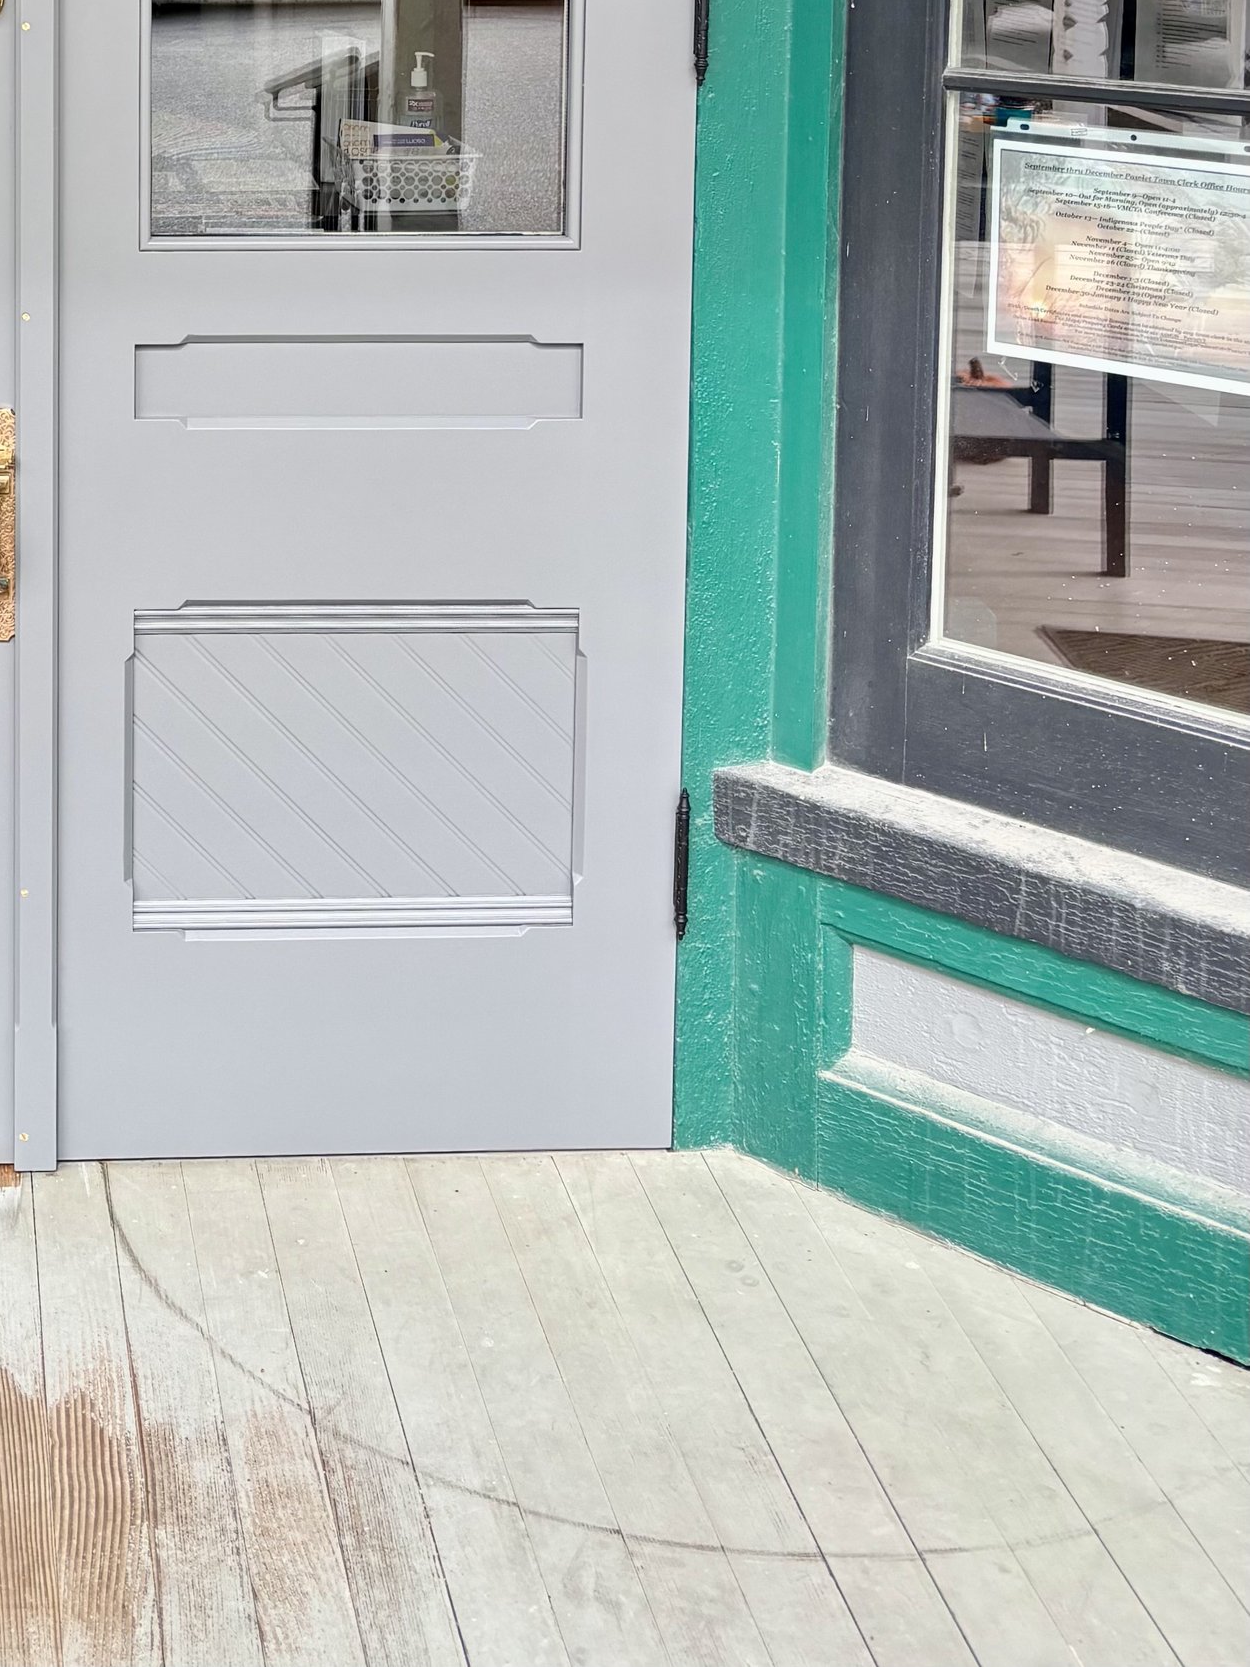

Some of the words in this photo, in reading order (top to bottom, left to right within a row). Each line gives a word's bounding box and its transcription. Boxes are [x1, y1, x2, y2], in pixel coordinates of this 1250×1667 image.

[1024, 161, 1065, 174] September
[1066, 166, 1083, 176] thru
[1085, 169, 1124, 180] December
[1177, 178, 1200, 189] Clerk
[1200, 181, 1224, 191] Office
[1093, 187, 1131, 198] September
[1091, 194, 1103, 202] for
[1138, 200, 1158, 209] Open
[1054, 197, 1093, 208] September
[1184, 212, 1216, 223] (Closed)
[1055, 211, 1083, 221] October
[1183, 225, 1215, 237] (Closed)
[1097, 222, 1125, 232] October
[1070, 240, 1107, 250] November
[1085, 235, 1123, 245] November
[1069, 254, 1105, 264] November
[1088, 249, 1125, 260] November
[1070, 274, 1105, 285] December
[1163, 288, 1194, 299] (Closed)
[1093, 270, 1129, 281] December
[1140, 277, 1170, 288] (Closed)
[1046, 285, 1081, 296] December
[1127, 296, 1152, 307] Happy
[1169, 302, 1188, 311] Year
[1188, 305, 1220, 317] (Closed)
[1095, 285, 1131, 295] December
[1141, 291, 1166, 302] (Open)
